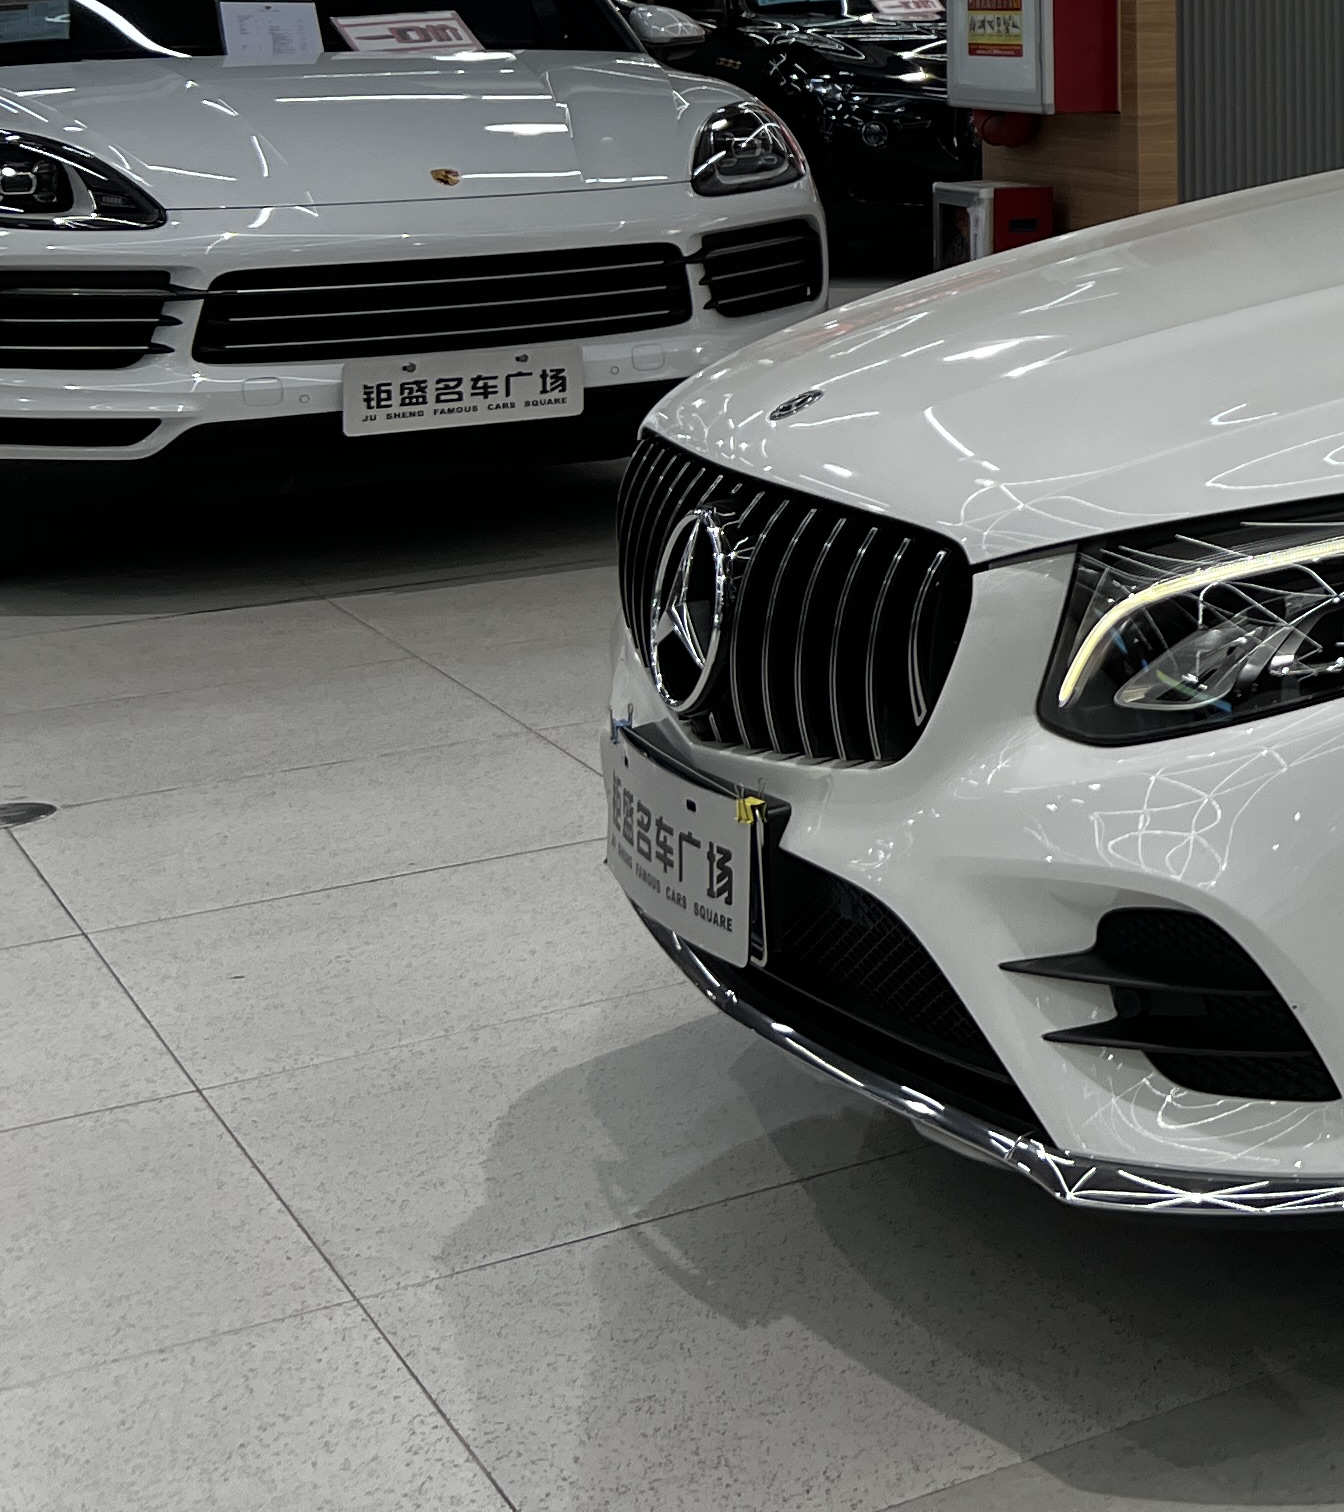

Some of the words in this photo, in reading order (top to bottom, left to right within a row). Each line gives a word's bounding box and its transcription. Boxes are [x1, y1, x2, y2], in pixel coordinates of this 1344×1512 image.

[362, 368, 568, 410] 钜盛名车广场
[362, 414, 377, 422] JU
[386, 410, 425, 420] SHENG
[433, 405, 479, 416] FAMOUS
[487, 401, 516, 411] CARS
[524, 396, 568, 408] SQUARE
[612, 769, 733, 906] 钜盛名车广场
[665, 885, 688, 910] CARS
[693, 901, 733, 933] SQUARE
